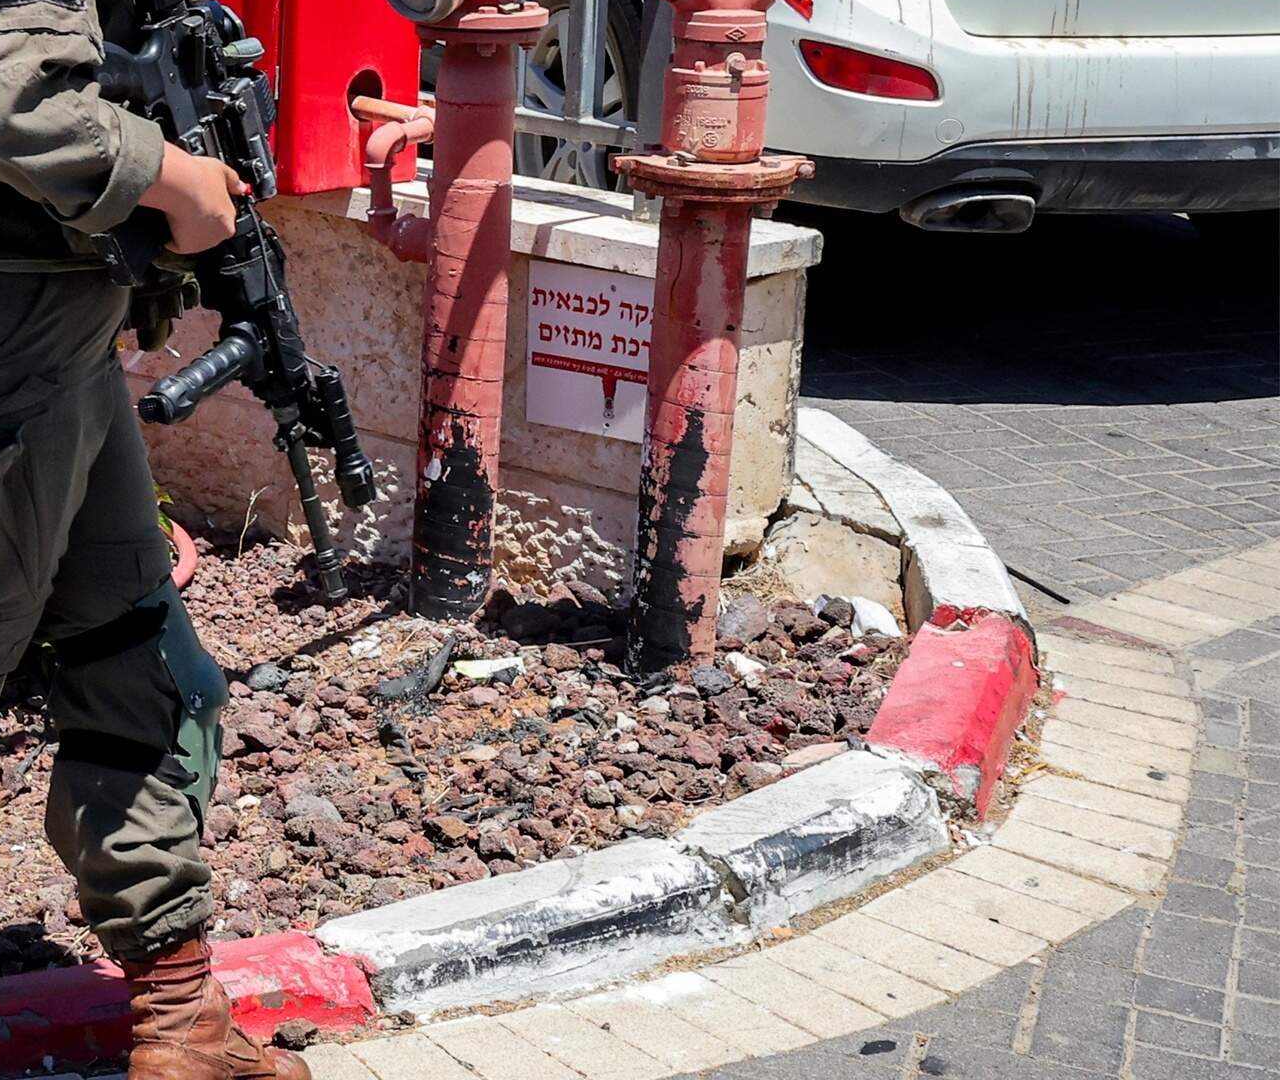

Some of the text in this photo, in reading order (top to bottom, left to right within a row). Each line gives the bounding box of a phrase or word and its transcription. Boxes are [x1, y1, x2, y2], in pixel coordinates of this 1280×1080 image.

[532, 286, 655, 328] קה לכבאית
[538, 321, 603, 351] מתזים
